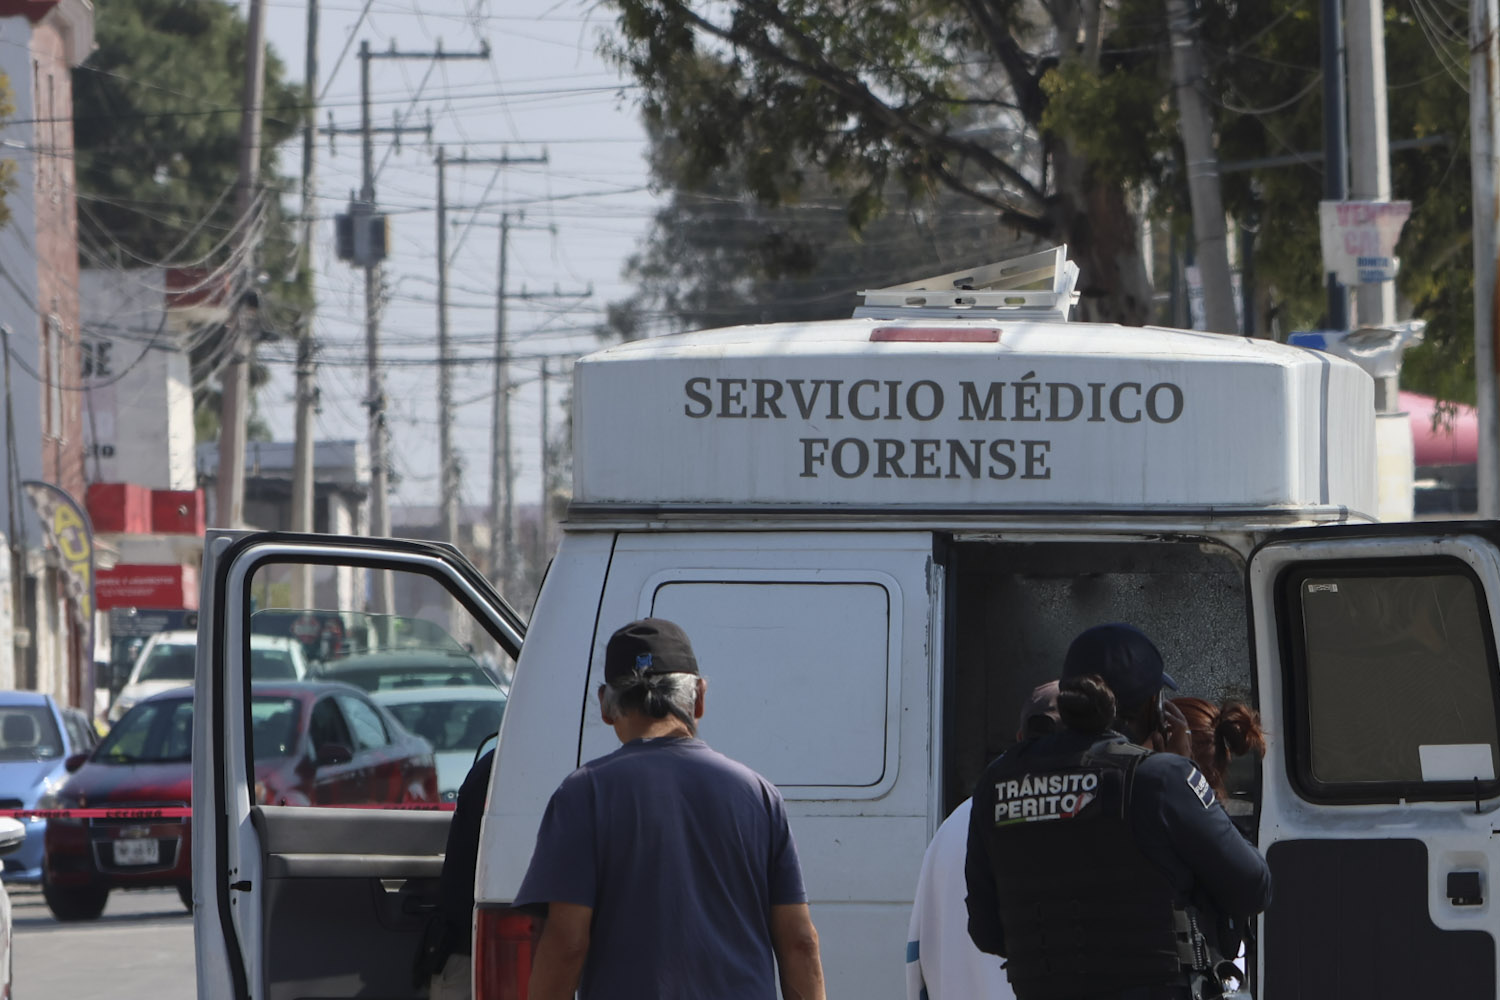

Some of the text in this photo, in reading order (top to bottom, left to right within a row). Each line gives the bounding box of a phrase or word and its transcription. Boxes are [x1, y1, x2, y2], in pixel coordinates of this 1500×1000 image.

[683, 370, 1186, 424] SERVICIO MÉDICO
[798, 436, 1053, 480] FORENSE
[995, 773, 1098, 801] TRÁNSITO
[994, 794, 1078, 822] PERITO
